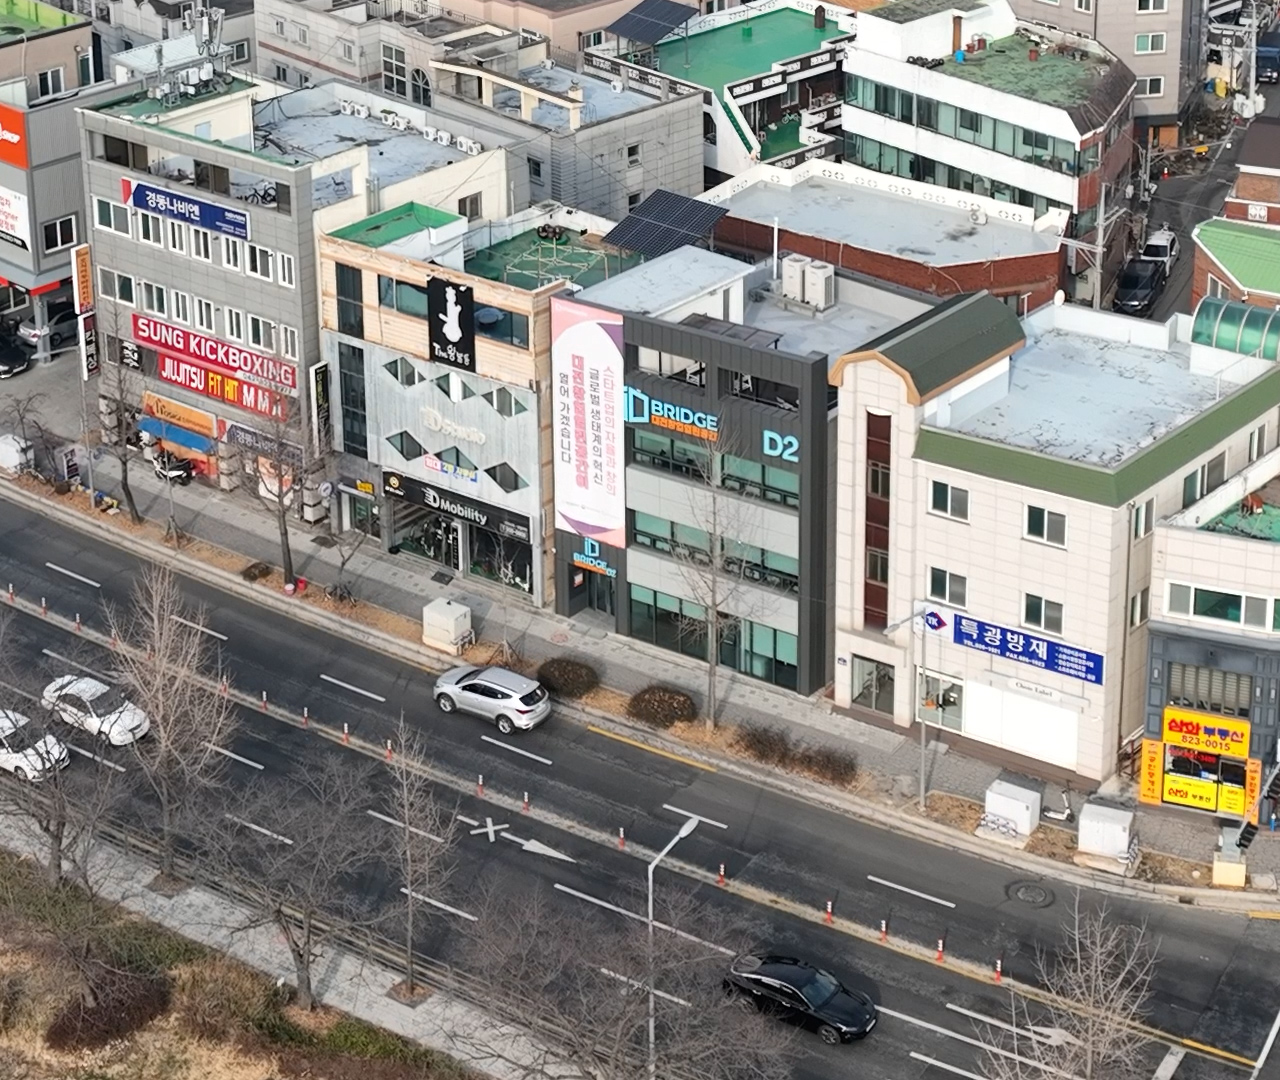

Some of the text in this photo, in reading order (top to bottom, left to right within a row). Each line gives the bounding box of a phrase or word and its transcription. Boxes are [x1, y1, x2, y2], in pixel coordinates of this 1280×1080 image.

[1, 130, 20, 144] SHOP
[145, 191, 200, 220] 경동나비엔
[138, 318, 293, 386] SUNG KICKBOXING
[161, 357, 205, 391] JIUJITSU
[208, 372, 222, 395] FIT
[224, 375, 238, 402] HIT
[590, 367, 600, 406] 글로벌
[603, 366, 616, 429] 스타트업의
[559, 373, 571, 463] 열어 가겠습니다
[590, 409, 602, 456] 생태계의
[651, 400, 718, 432] BRIDGE
[763, 429, 800, 463] D2
[440, 500, 487, 525] Mobility
[573, 552, 607, 570] BRIDGE
[960, 619, 1048, 661] 특광방재
[1168, 718, 1245, 744] 삼화 부동산
[1181, 735, 1231, 752] 823-0015
[1147, 756, 1157, 794] 공인중개사
[1168, 788, 1212, 803] 삼화 부동산
